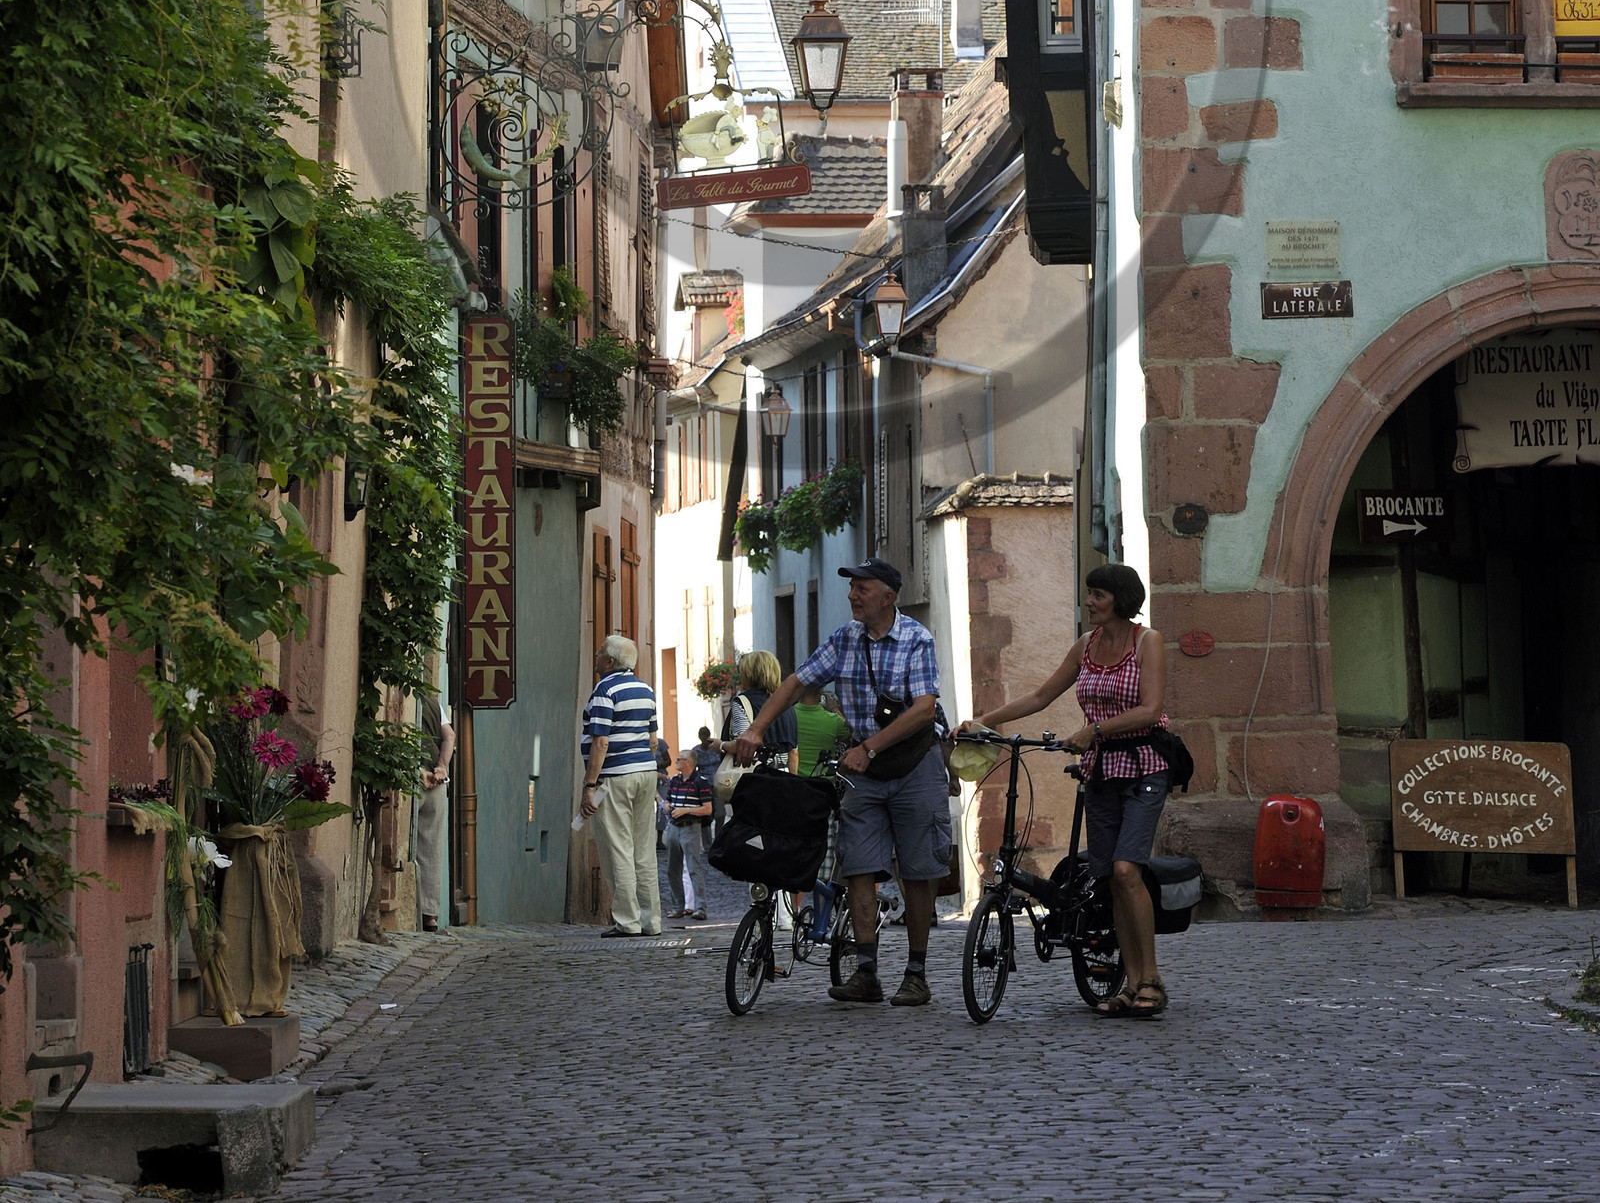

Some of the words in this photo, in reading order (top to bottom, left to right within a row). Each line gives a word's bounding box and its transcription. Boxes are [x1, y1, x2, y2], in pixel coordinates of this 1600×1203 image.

[668, 185, 690, 202] La
[692, 183, 726, 199] Table
[727, 180, 744, 195] du
[746, 175, 799, 194] Gourmet
[1293, 287, 1319, 298] RUE
[1273, 300, 1342, 313] LATERALE
[1473, 345, 1593, 374] RESTAURANT
[1536, 382, 1555, 408] du
[1510, 419, 1568, 446] TARTE
[1576, 419, 1600, 449] FL
[468, 323, 511, 700] RESTAURANT
[1365, 496, 1445, 516] BROCANTE
